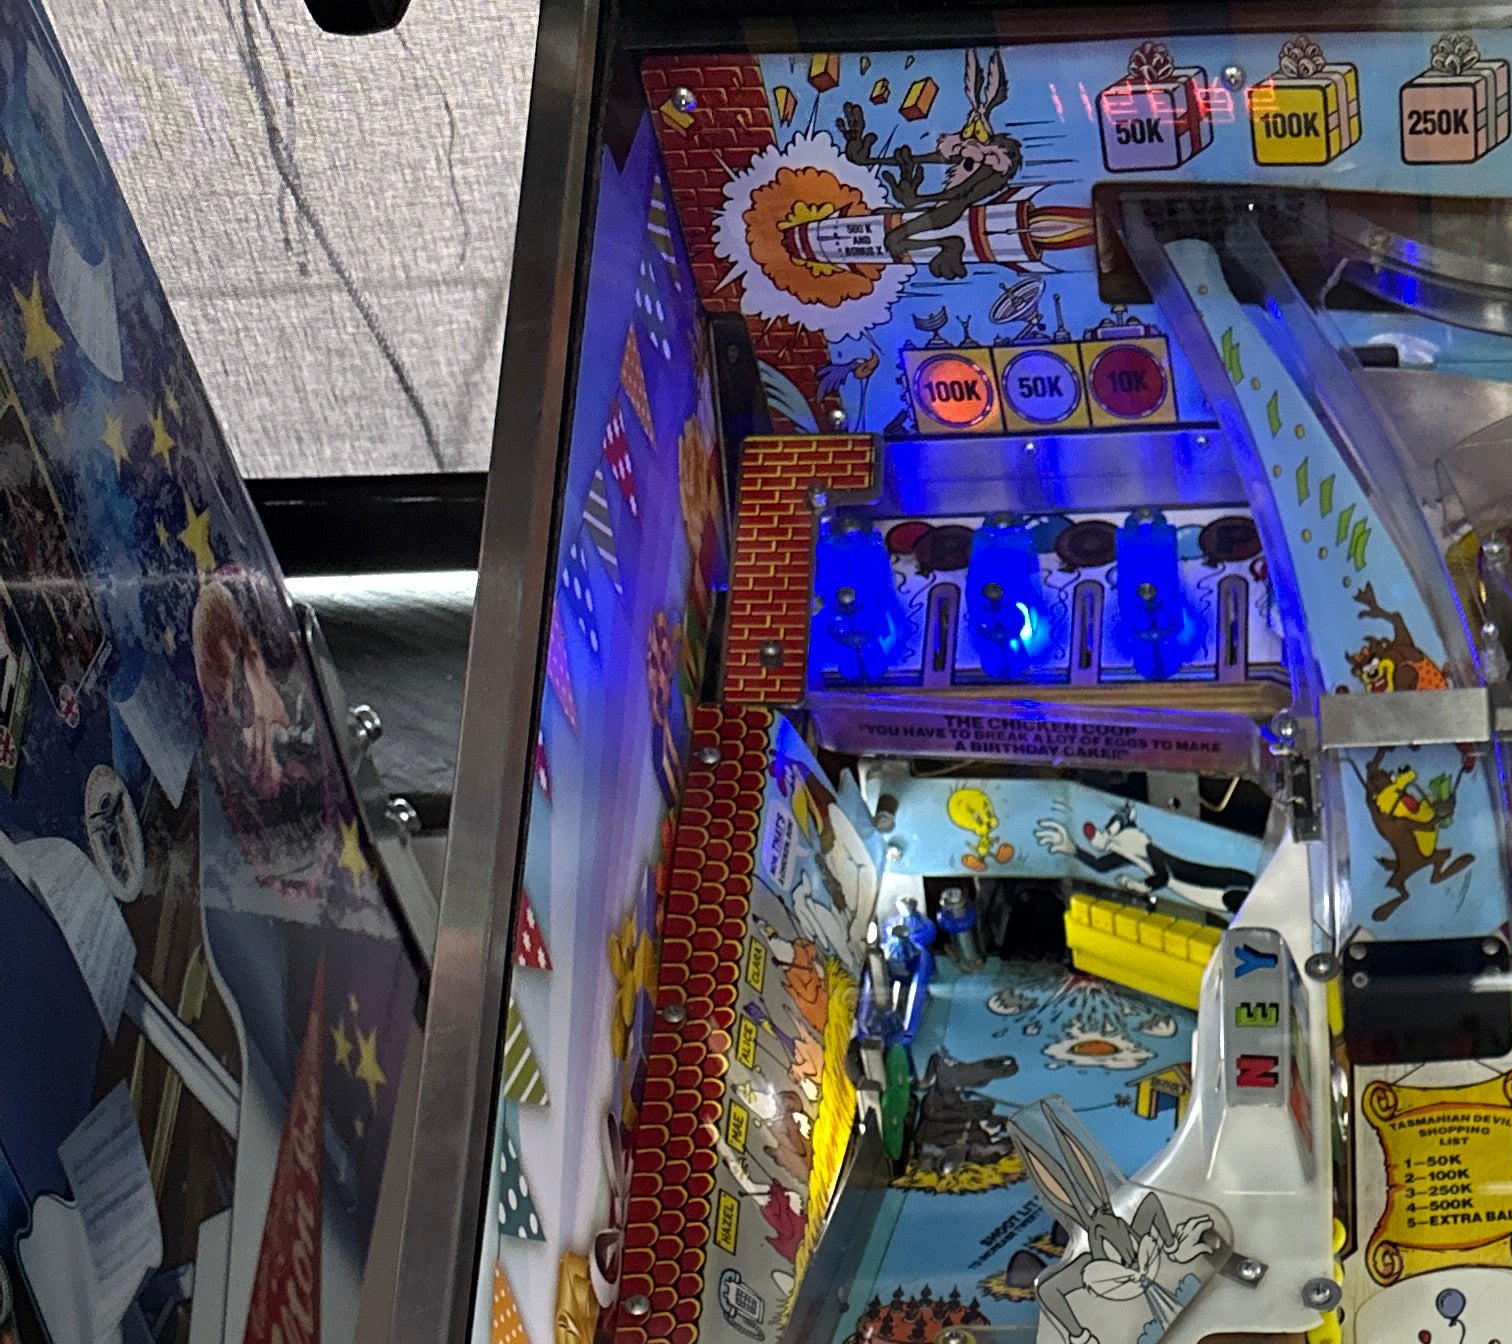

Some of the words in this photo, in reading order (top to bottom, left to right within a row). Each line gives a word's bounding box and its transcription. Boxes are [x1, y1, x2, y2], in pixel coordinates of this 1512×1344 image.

[1116, 116, 1165, 146] 50K
[1259, 110, 1320, 142] 100K
[1408, 108, 1469, 139] 250K
[924, 379, 981, 403] 100K
[1018, 374, 1064, 400] 50K
[1108, 369, 1150, 392] 10K
[944, 714, 984, 731] THE
[988, 717, 1078, 735] CHICKEN
[1082, 724, 1137, 736] COOP
[1390, 1115, 1470, 1131] TASMANIAN
[1473, 1114, 1512, 1126] DEVIL
[1419, 1127, 1490, 1137] SHOPPING
[1440, 1138, 1469, 1146] LIST
